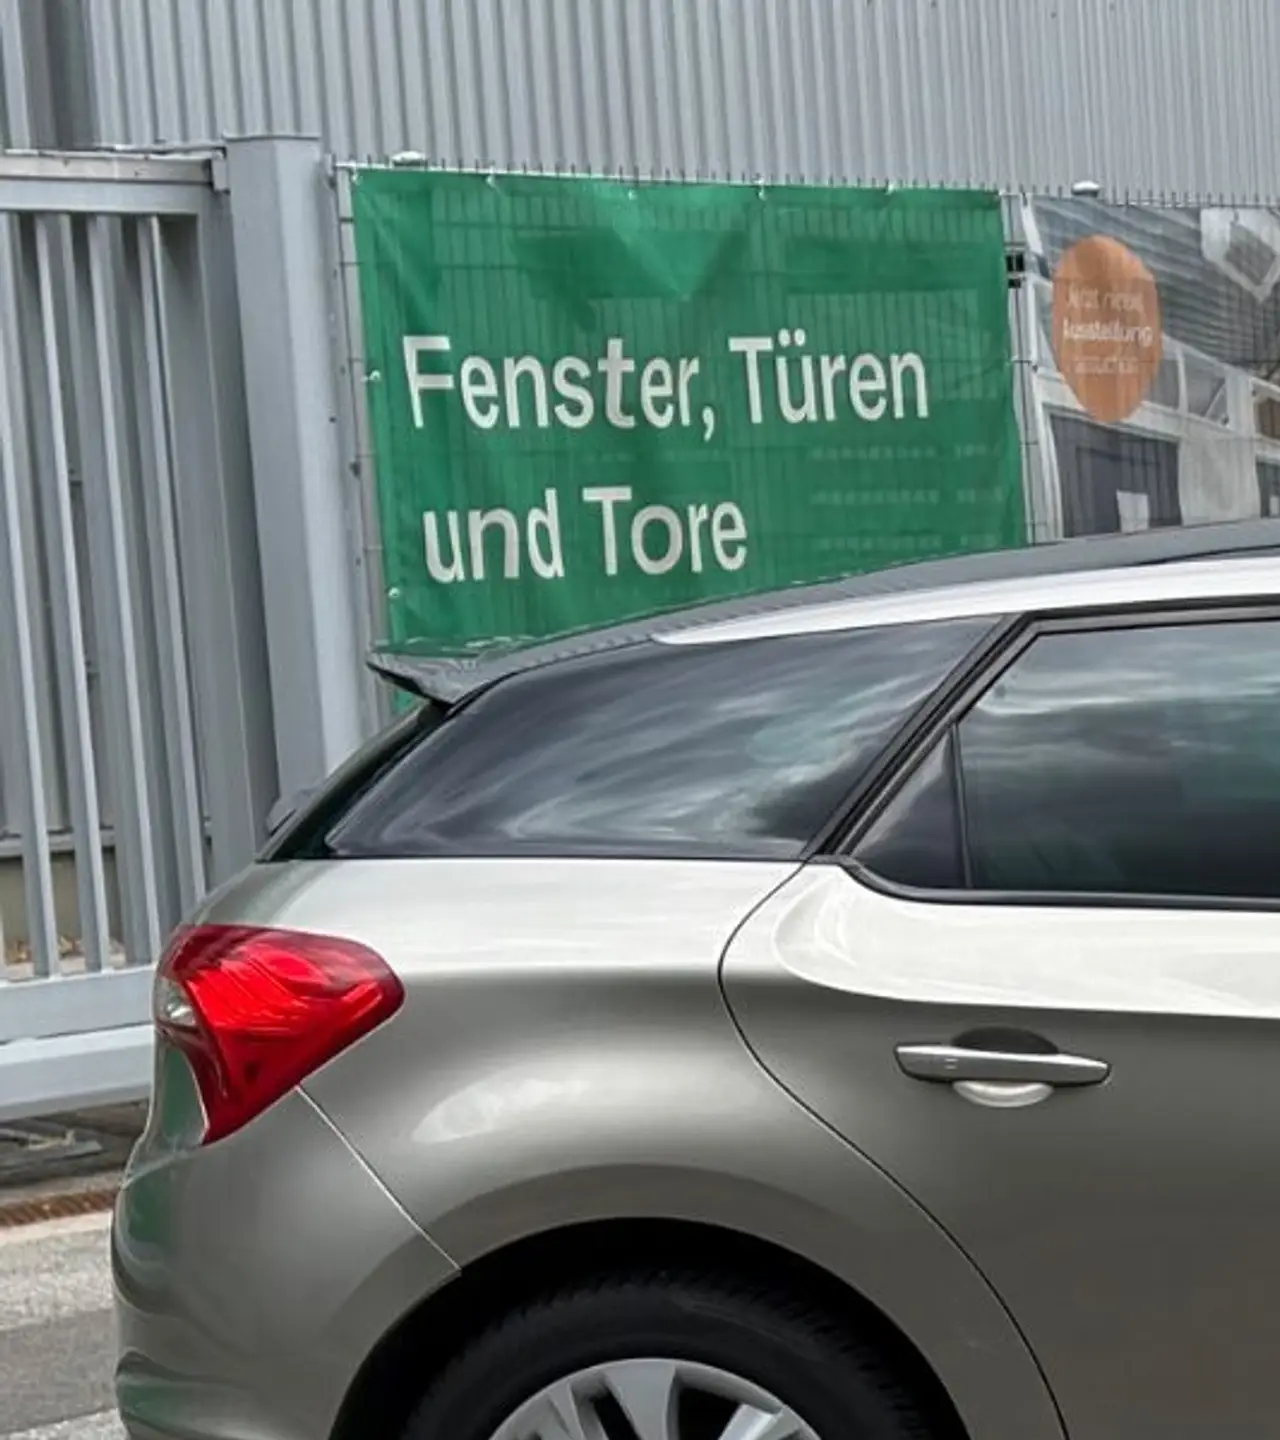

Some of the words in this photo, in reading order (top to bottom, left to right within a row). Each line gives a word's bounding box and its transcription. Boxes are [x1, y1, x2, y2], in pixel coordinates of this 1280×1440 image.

[402, 335, 716, 441] Fenster,
[728, 328, 929, 425] Türen
[422, 488, 565, 583] und
[582, 486, 748, 577] Tore
